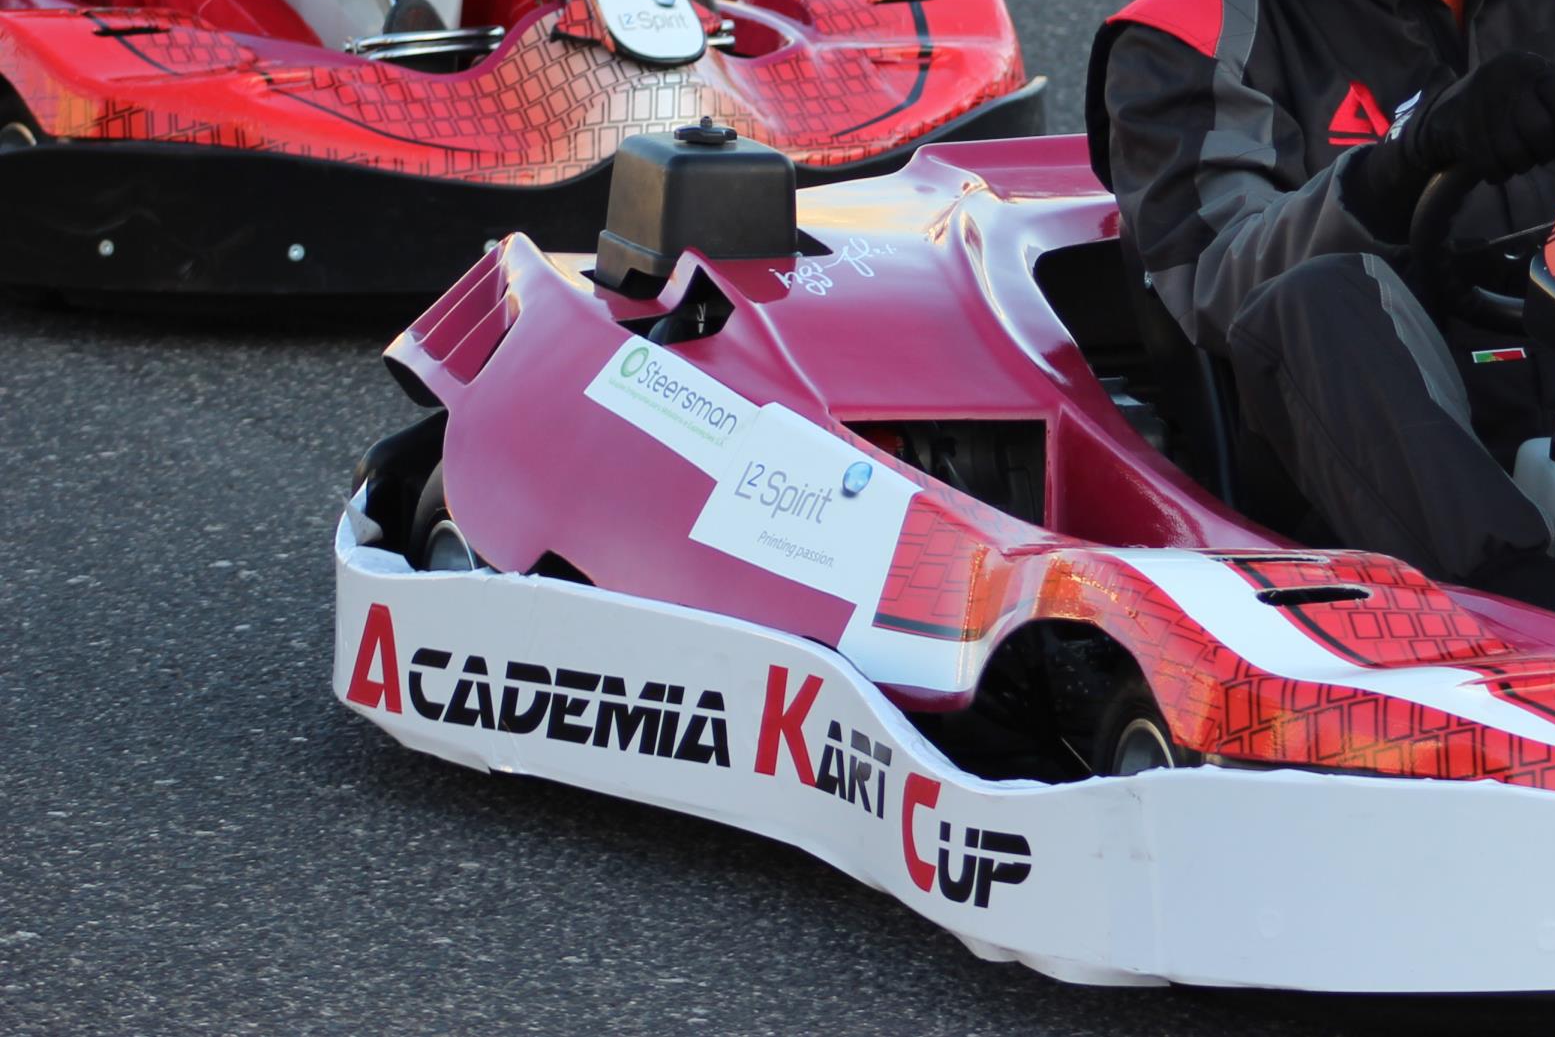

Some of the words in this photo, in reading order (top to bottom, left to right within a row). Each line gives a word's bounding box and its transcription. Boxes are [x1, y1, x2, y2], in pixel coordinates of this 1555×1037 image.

[637, 361, 738, 435] Steersman
[760, 470, 833, 525] Spirit
[756, 530, 798, 557] Printing
[347, 603, 731, 768] ACADEMIA
[753, 665, 892, 819] KART
[902, 773, 1032, 908] CUP
